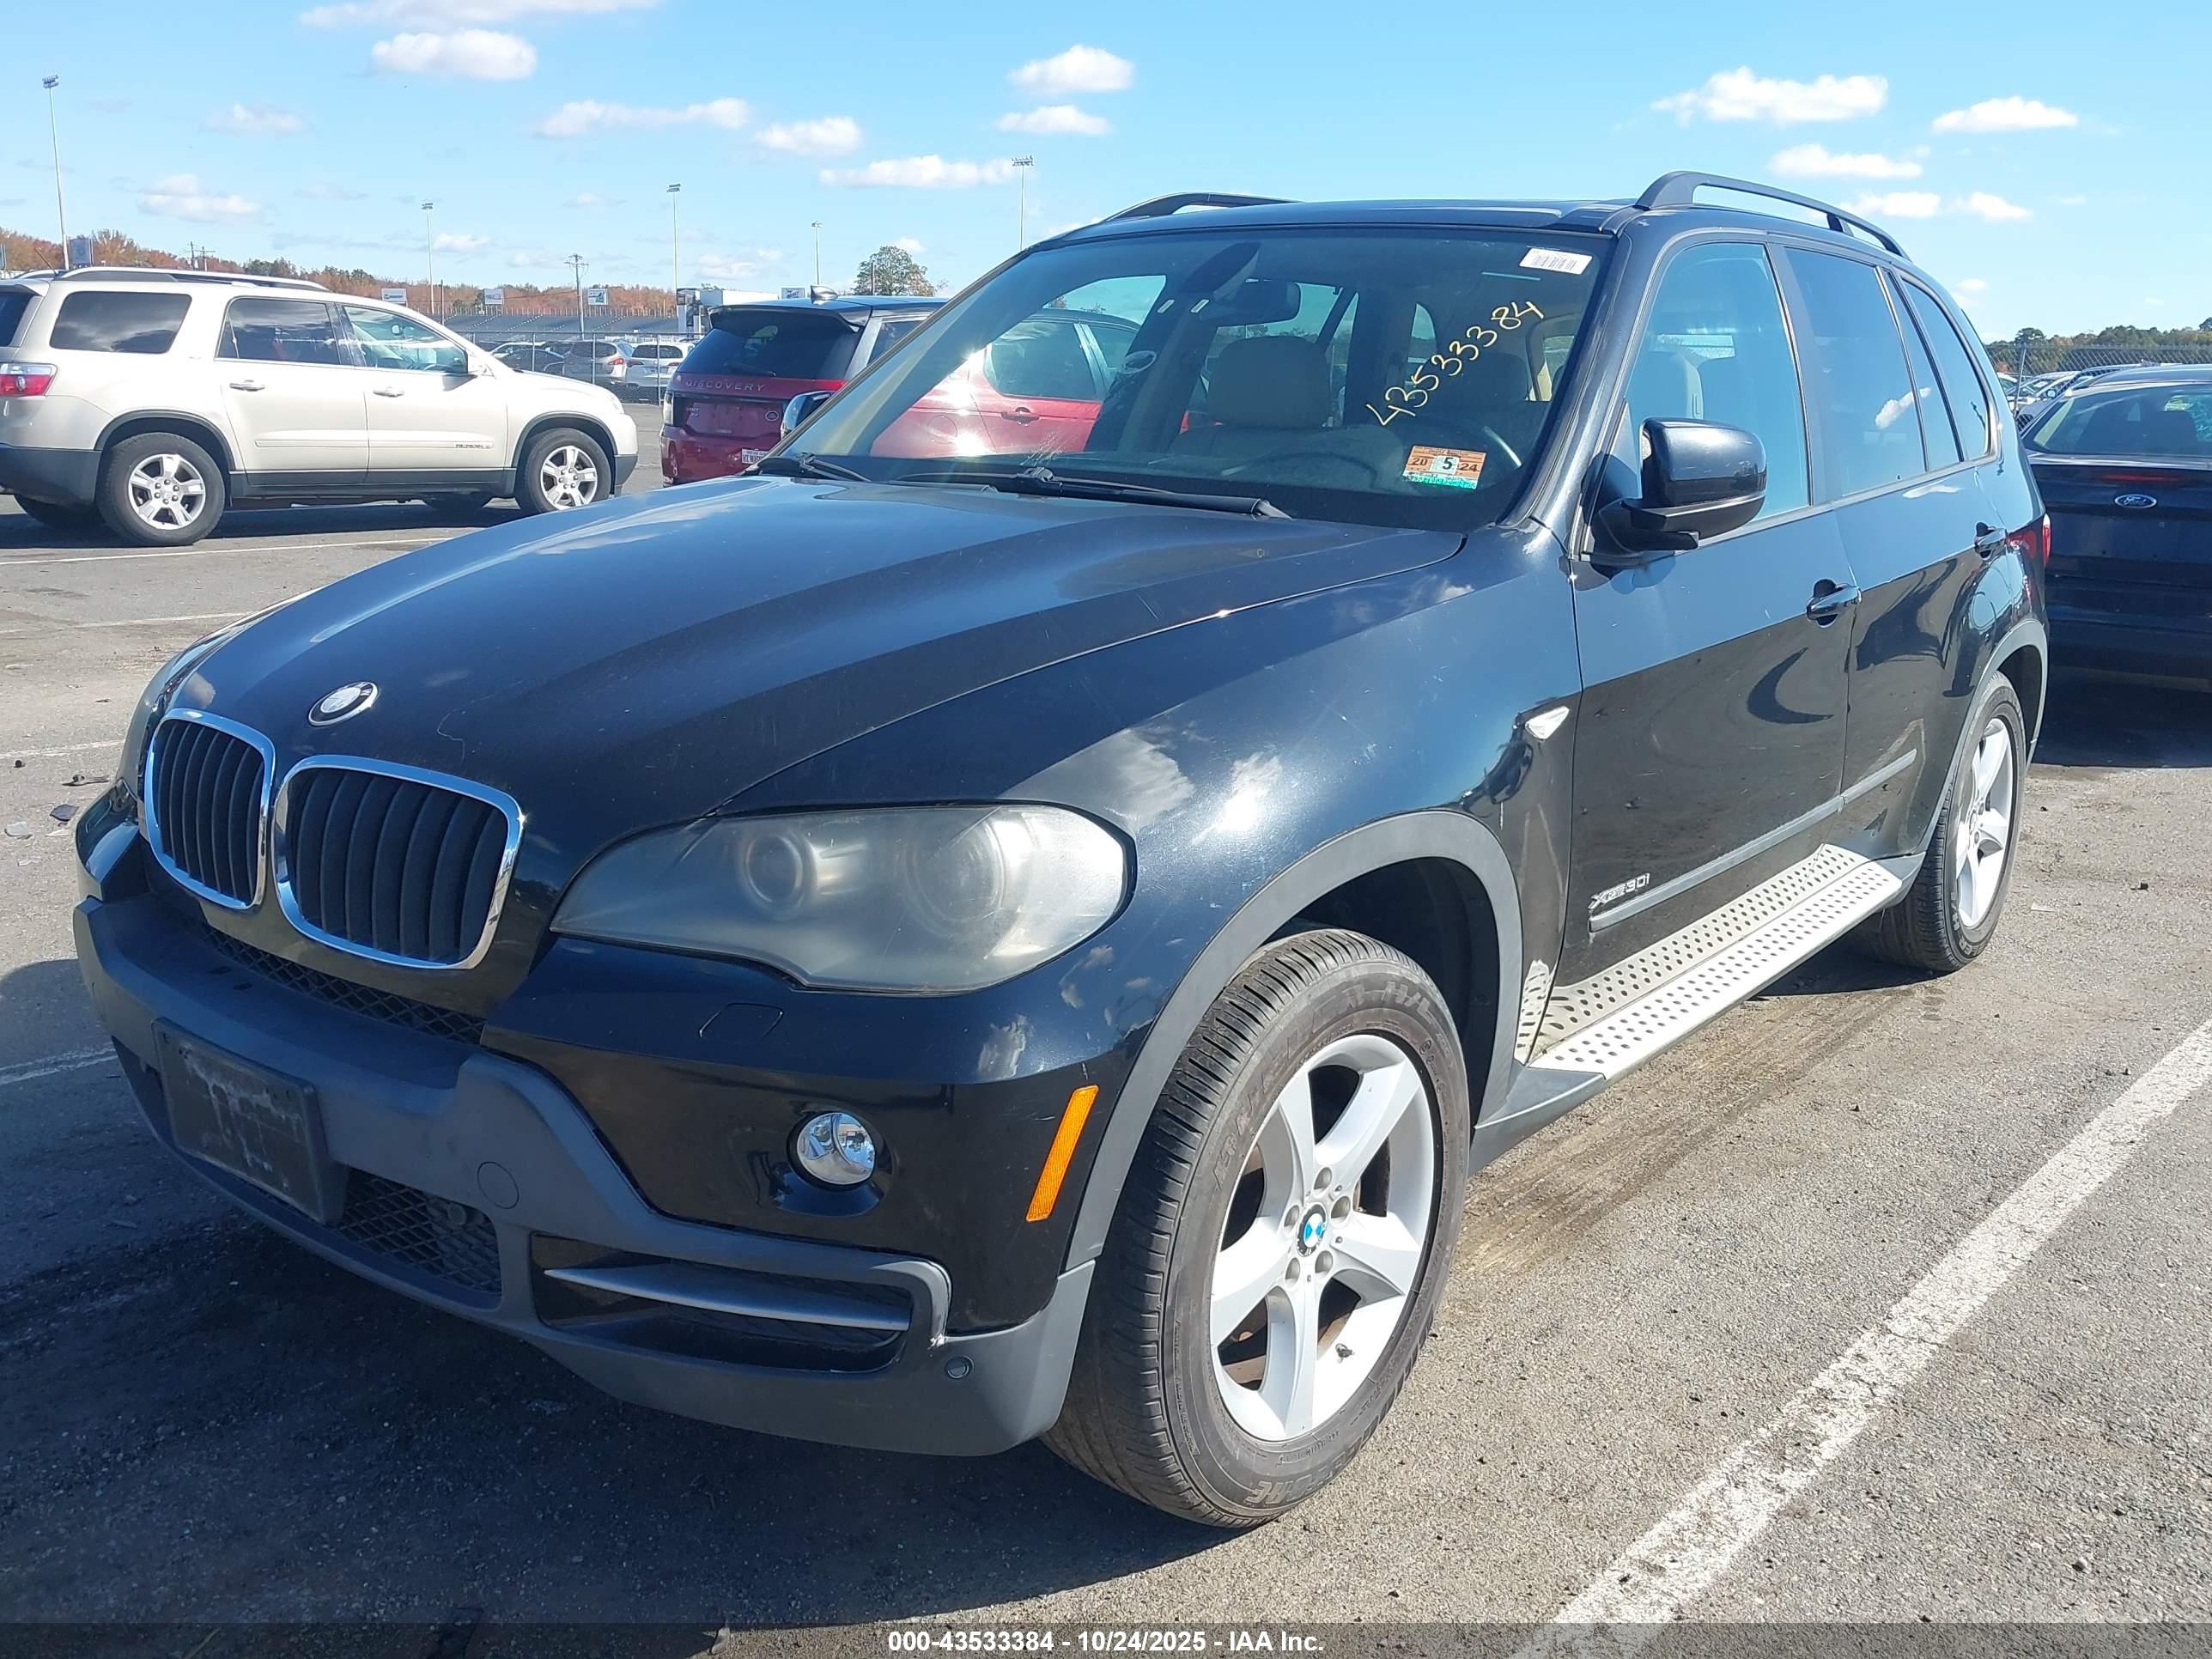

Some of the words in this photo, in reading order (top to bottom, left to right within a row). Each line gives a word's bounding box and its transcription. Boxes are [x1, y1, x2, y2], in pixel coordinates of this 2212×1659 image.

[1365, 301, 1544, 426] 43533384
[686, 380, 765, 392] DISCOVERY
[1410, 457, 1428, 466] 20
[1442, 457, 1454, 470] 5
[1460, 463, 1478, 471] 24
